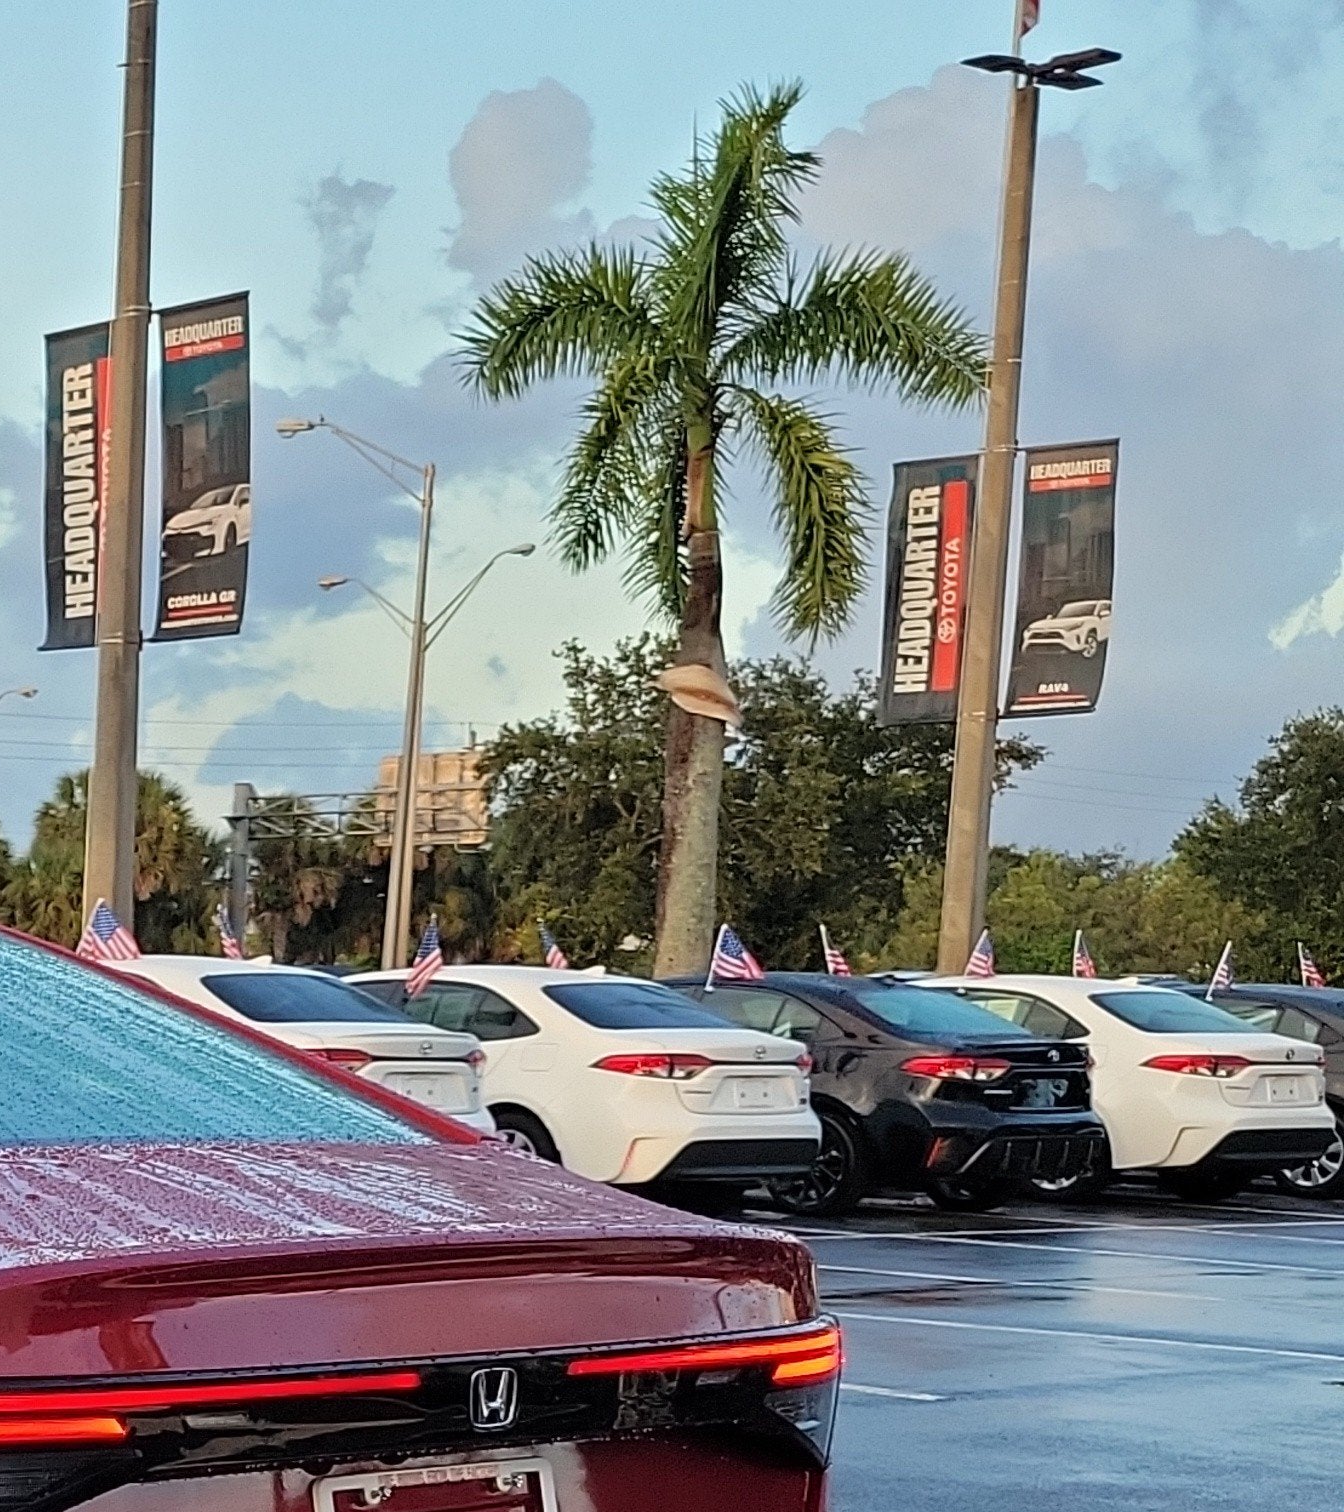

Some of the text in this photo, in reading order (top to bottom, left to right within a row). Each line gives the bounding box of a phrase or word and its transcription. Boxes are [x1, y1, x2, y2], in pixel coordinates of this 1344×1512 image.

[164, 314, 244, 349] HEADQUARTER
[63, 362, 99, 619] HEADQUARTER
[1029, 458, 1111, 480] HEADQUARTER
[893, 485, 941, 693] HEADQUARTER
[940, 537, 961, 618] TOYOTA
